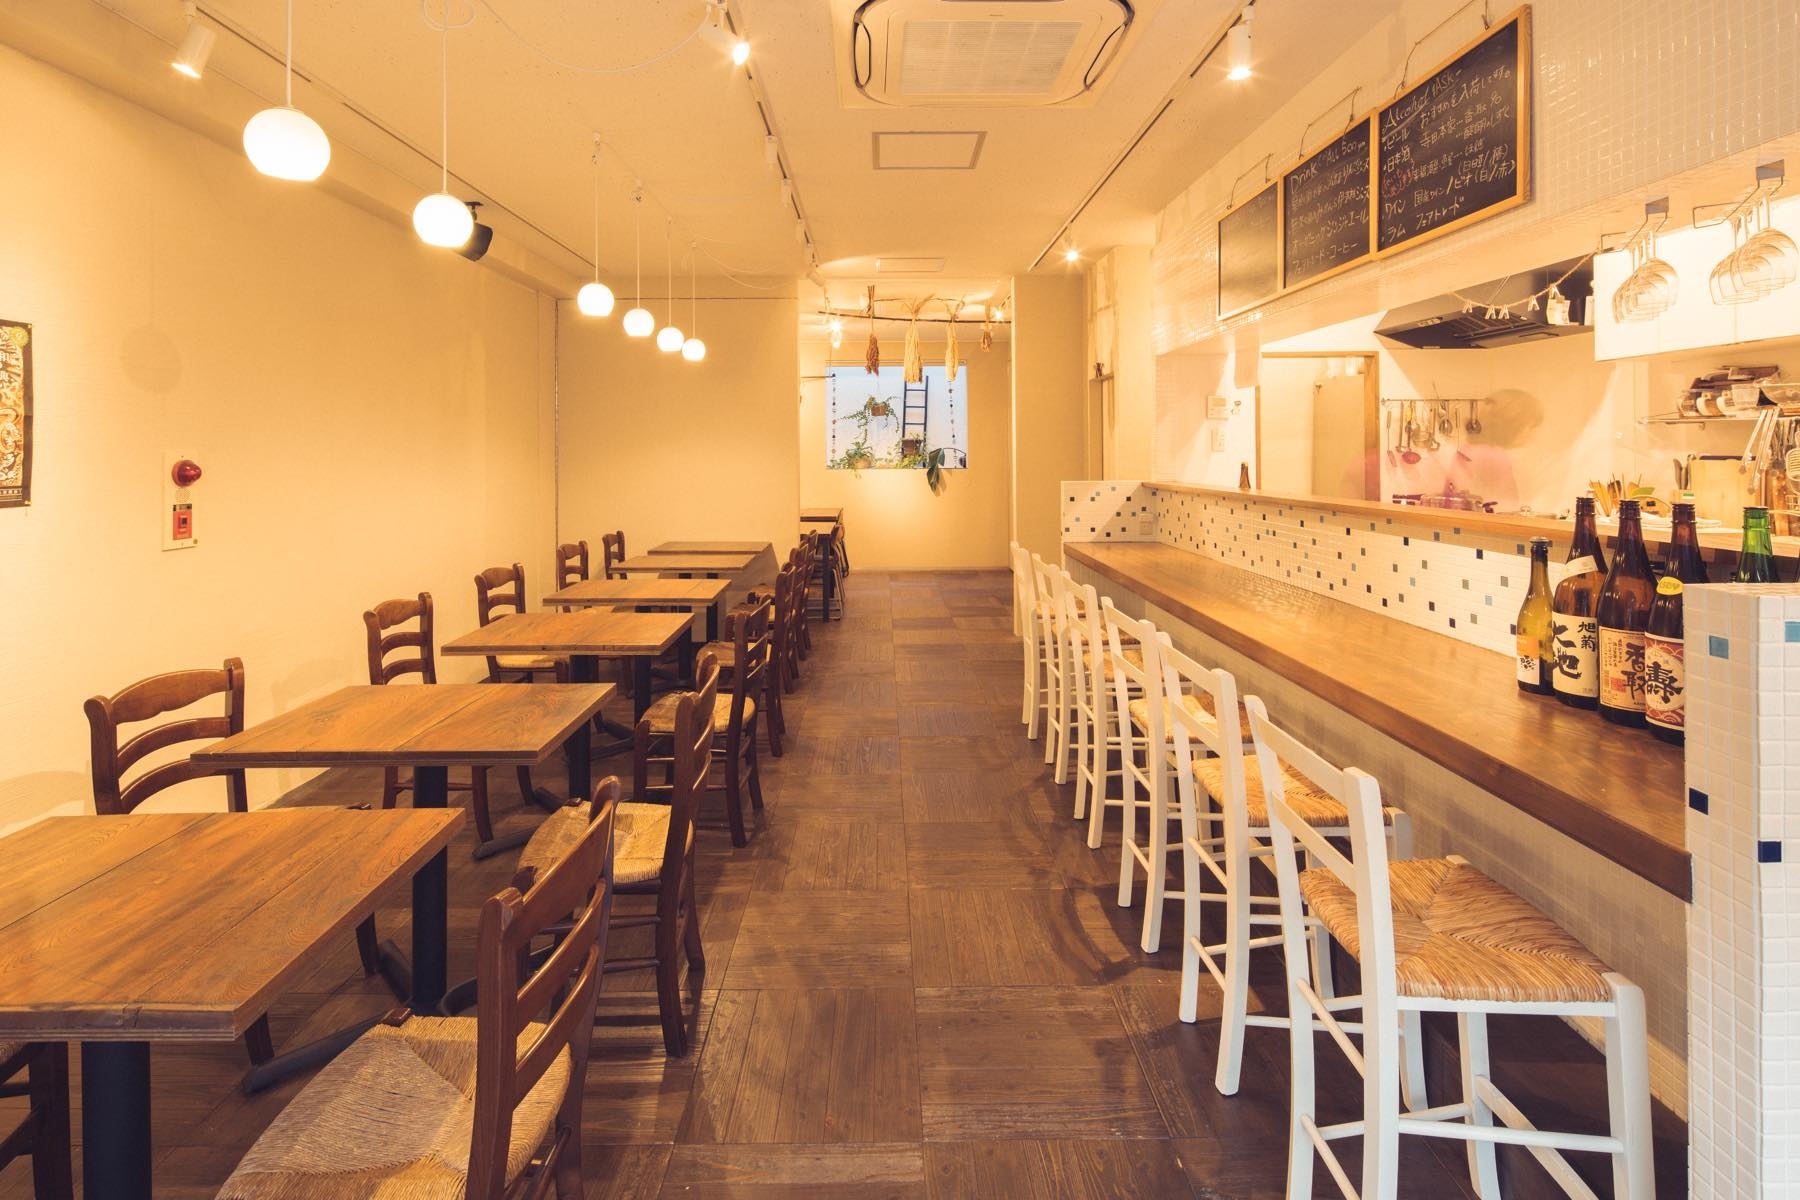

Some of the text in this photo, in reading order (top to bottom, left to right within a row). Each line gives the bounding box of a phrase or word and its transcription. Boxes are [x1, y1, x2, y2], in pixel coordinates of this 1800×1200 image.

[1387, 145, 1411, 173] 日本酒
[1290, 164, 1319, 194] Drink
[1385, 200, 1406, 219] ワイン
[1387, 223, 1407, 242] ラム
[1577, 621, 1597, 652] 旭菊
